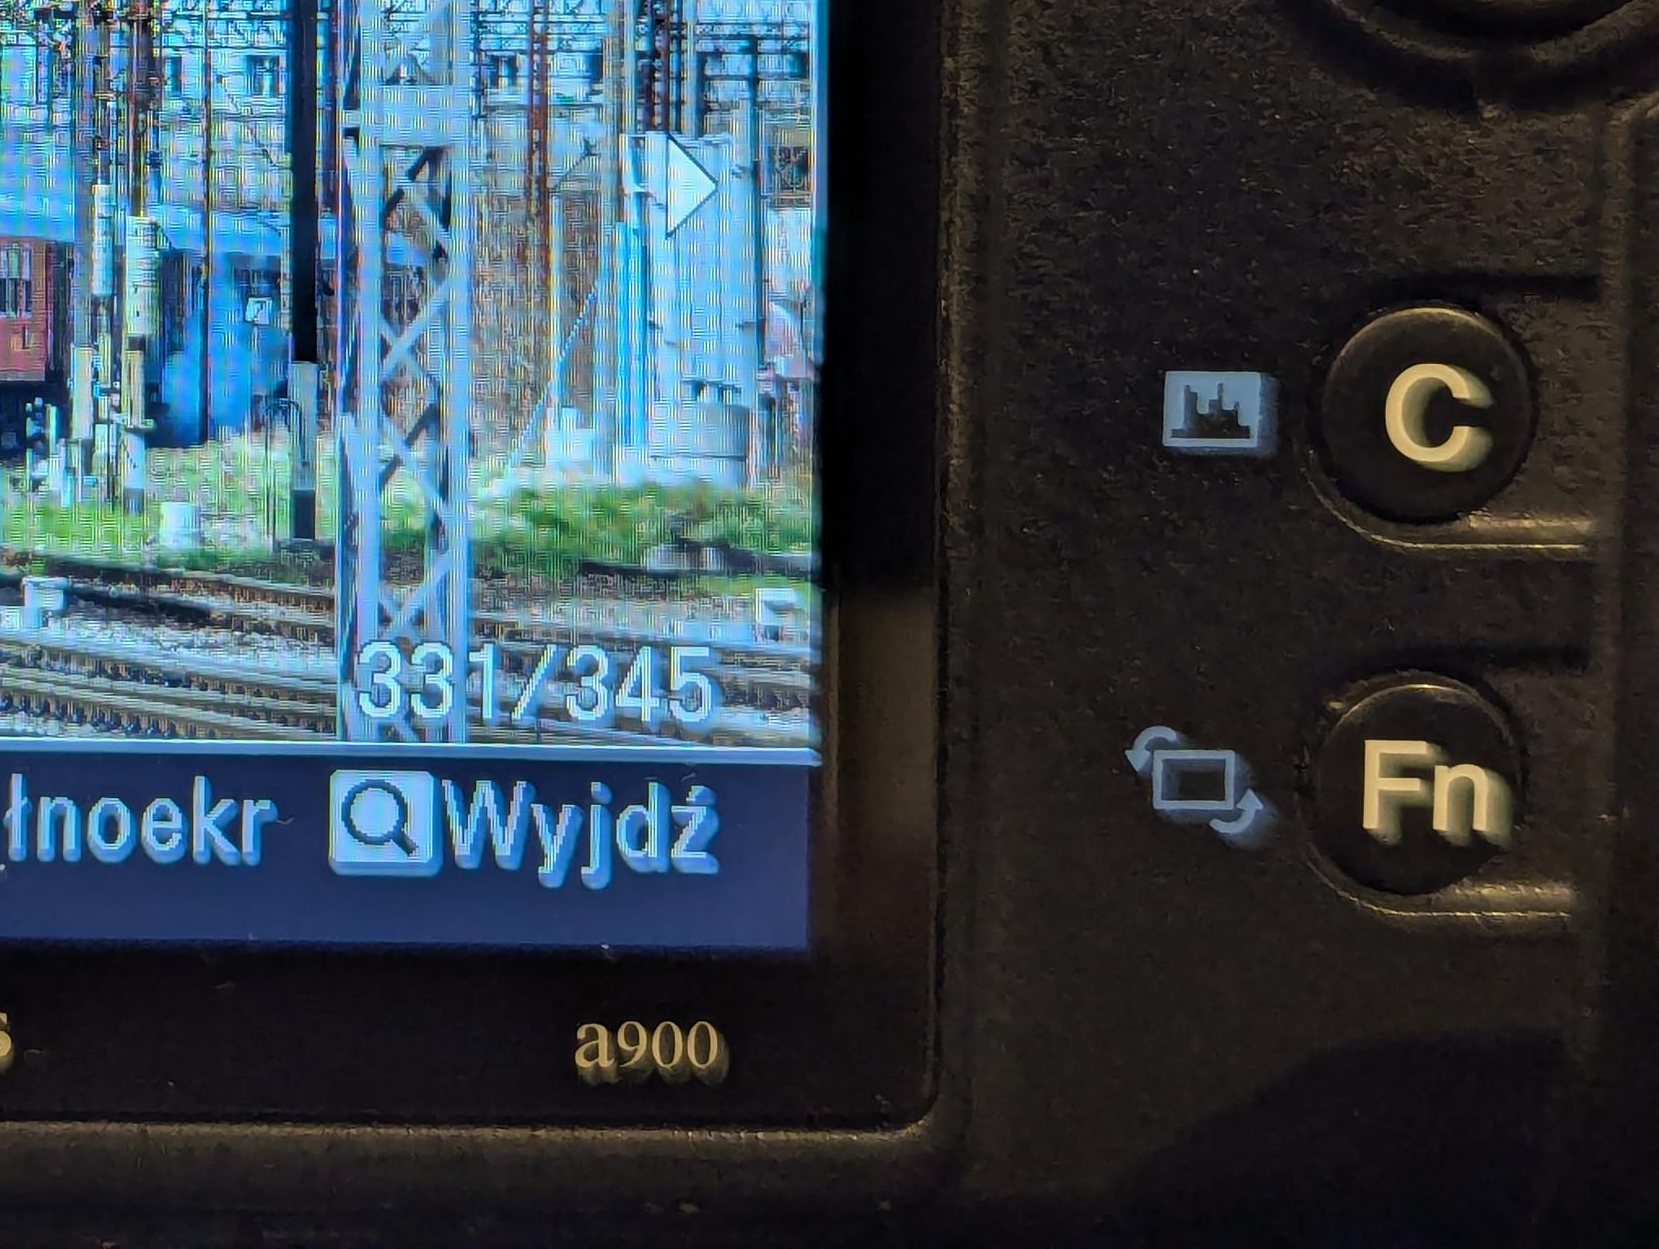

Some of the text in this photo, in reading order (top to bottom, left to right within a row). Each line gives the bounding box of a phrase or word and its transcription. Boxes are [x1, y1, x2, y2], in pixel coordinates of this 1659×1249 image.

[1385, 362, 1494, 472] C
[357, 640, 716, 724] 331/345
[441, 779, 720, 889] Wyjdź
[1363, 739, 1514, 846] Fn
[574, 1020, 720, 1071] a900
